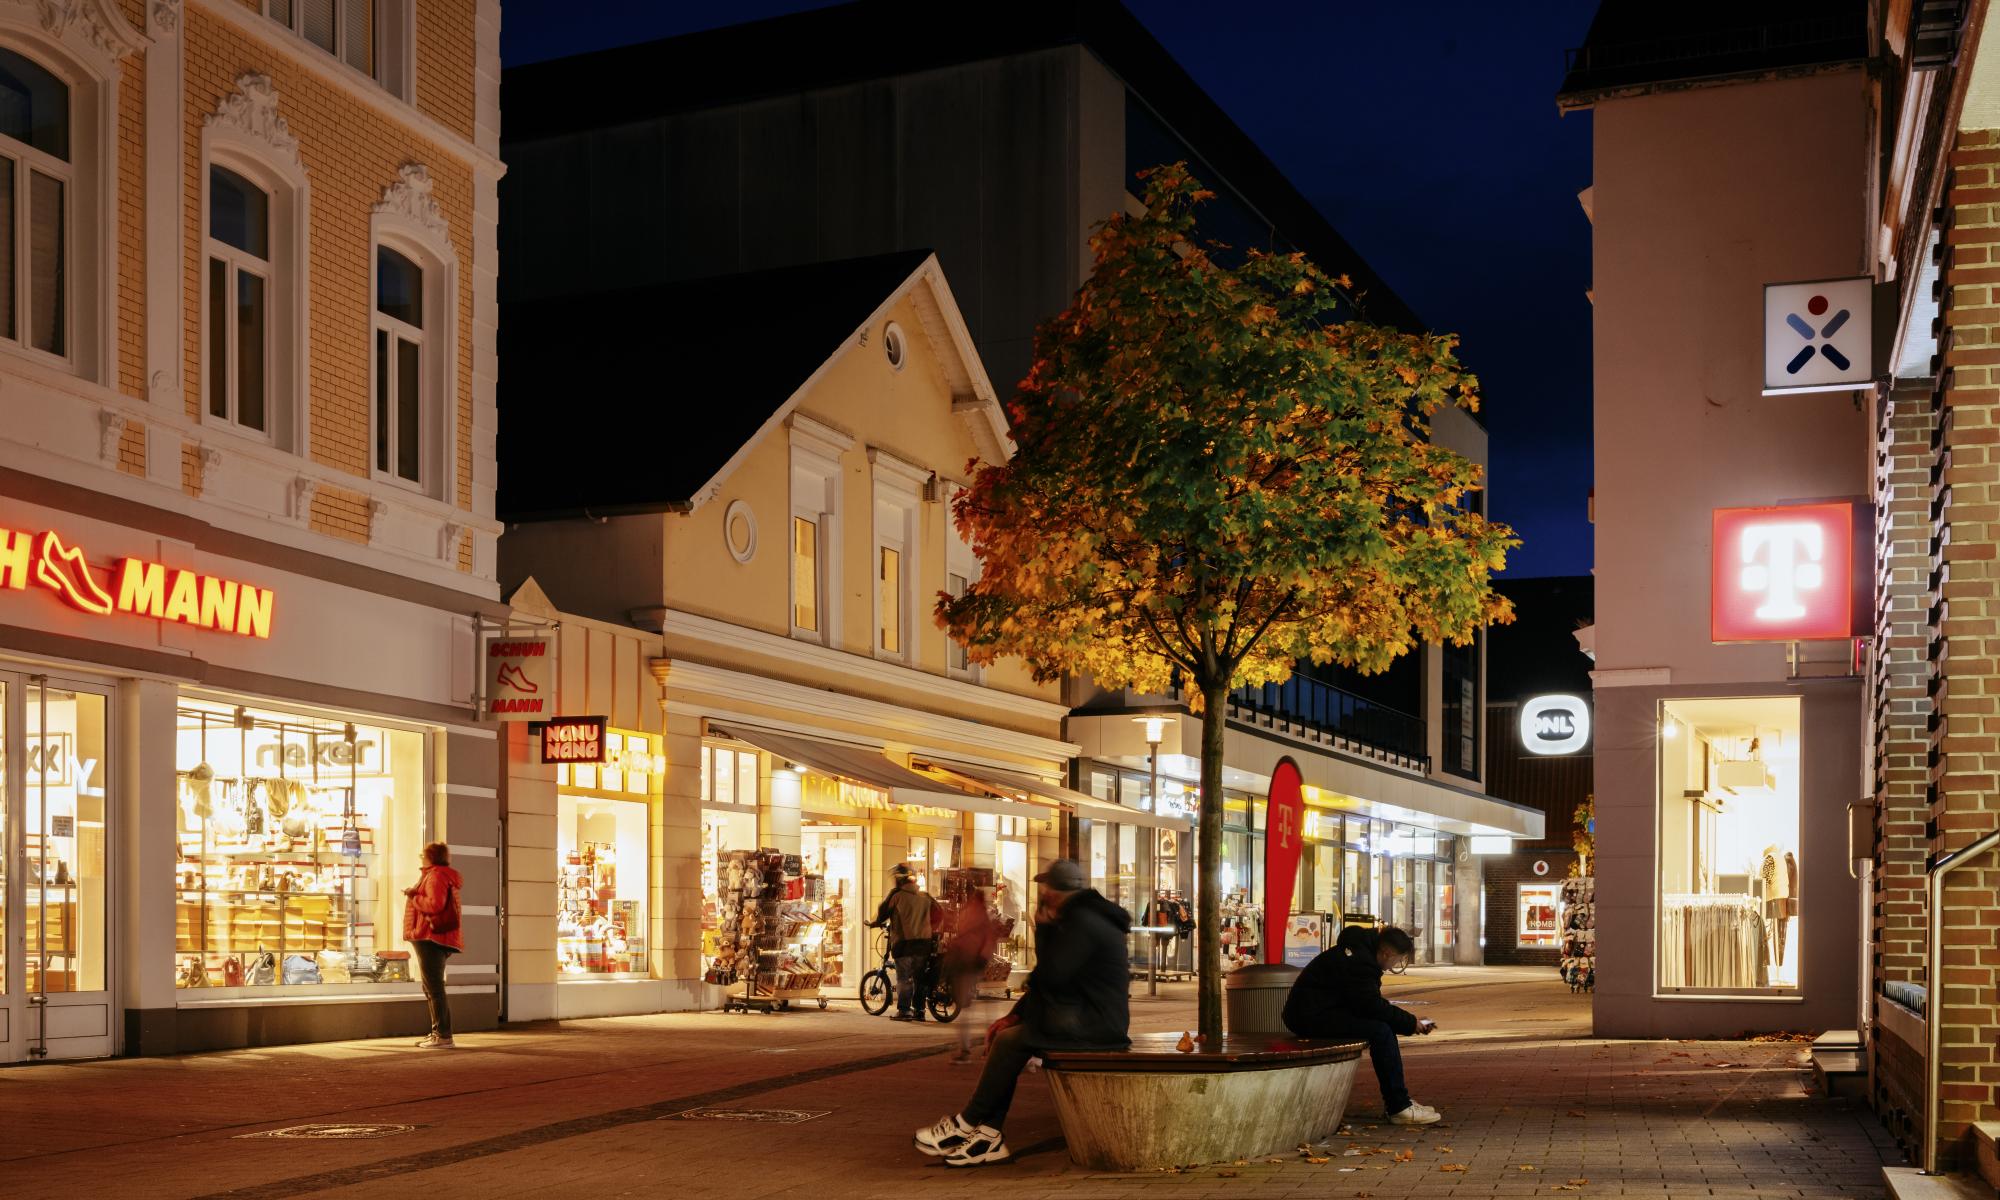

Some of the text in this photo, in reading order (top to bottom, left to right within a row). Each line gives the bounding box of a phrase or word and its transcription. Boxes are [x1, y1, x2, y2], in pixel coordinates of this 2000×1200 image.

[1741, 522, 1823, 620] T
[117, 557, 274, 639] MANN
[489, 642, 546, 657] SCHUH
[491, 698, 543, 713] MANN
[256, 733, 376, 768] rieker
